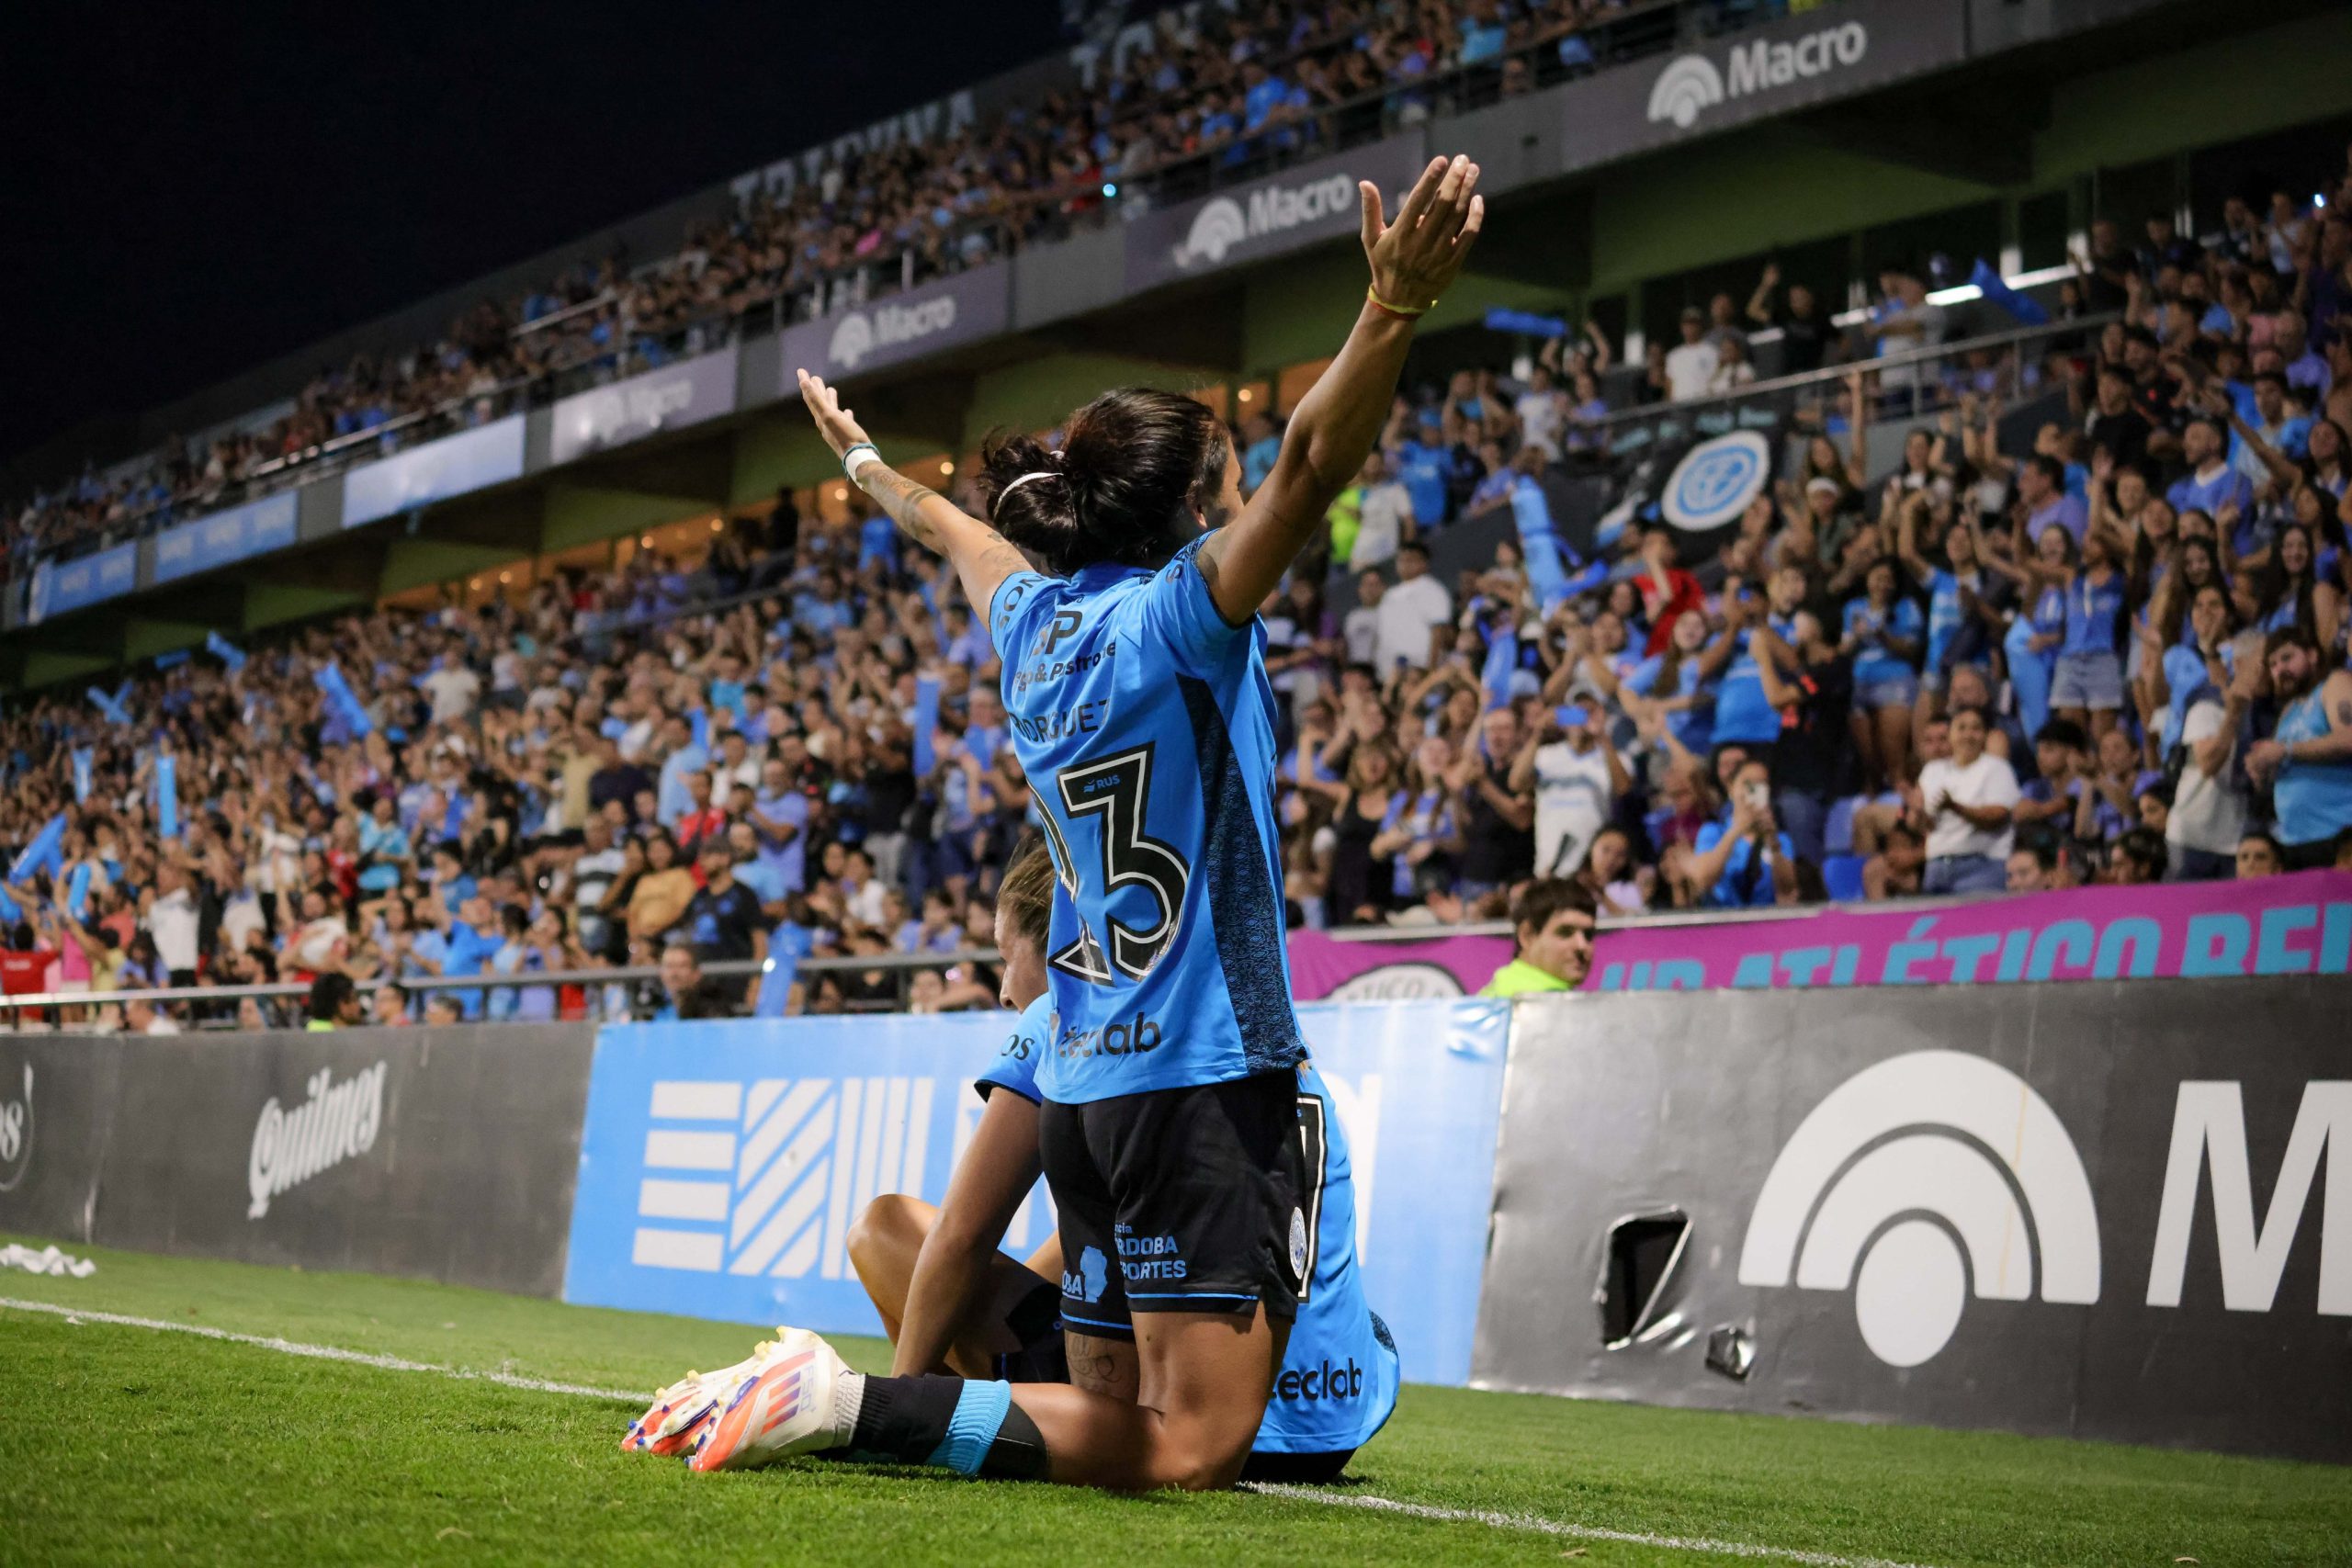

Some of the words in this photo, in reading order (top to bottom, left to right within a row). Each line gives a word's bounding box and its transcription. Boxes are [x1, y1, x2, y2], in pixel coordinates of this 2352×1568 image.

[1728, 20, 1868, 98] Macro
[1248, 173, 1354, 236] Macro
[1049, 641, 1116, 682] Pstroe
[1096, 774, 1121, 789] RUS
[246, 1059, 387, 1221] Quilmes
[1114, 1235, 1179, 1256] RDOBA
[1118, 1259, 1187, 1280] PORTES
[1272, 1357, 1363, 1402] eclab
